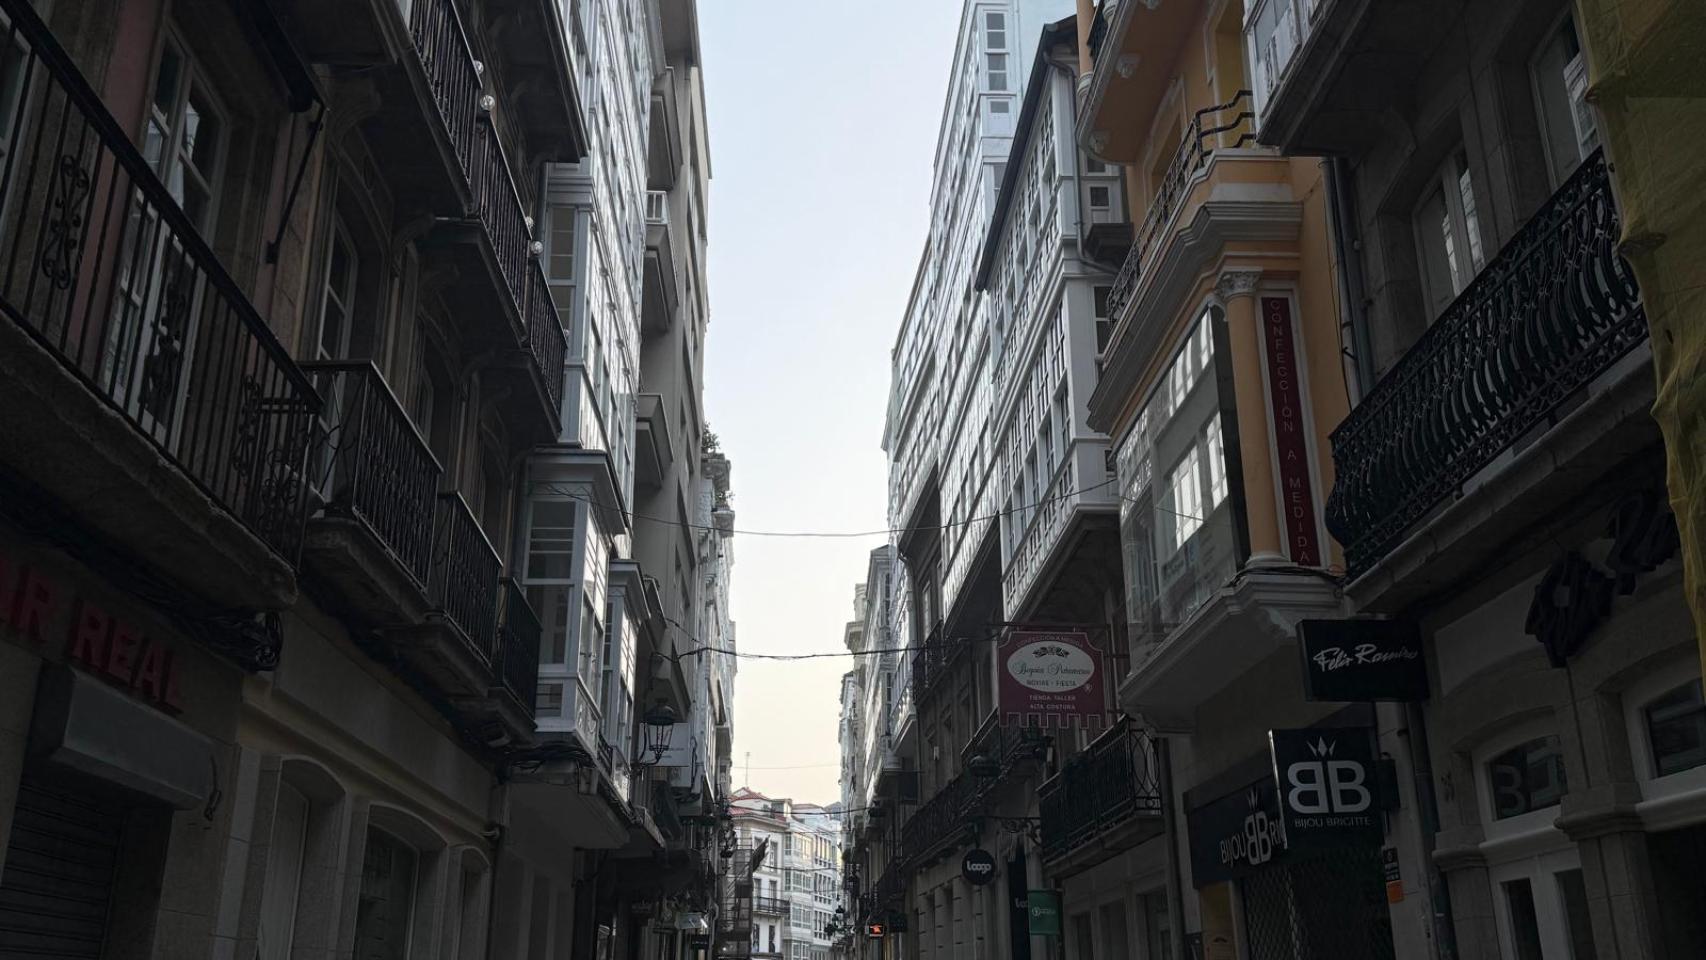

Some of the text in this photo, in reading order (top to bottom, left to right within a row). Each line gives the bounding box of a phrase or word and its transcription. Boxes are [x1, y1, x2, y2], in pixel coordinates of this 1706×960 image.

[1287, 450, 1297, 461] A
[1289, 477, 1310, 563] MEDIDA
[70, 598, 186, 711] REAL
[1294, 816, 1373, 829] BIJOU BRIGITTE
[1219, 832, 1246, 868] BIJOU
